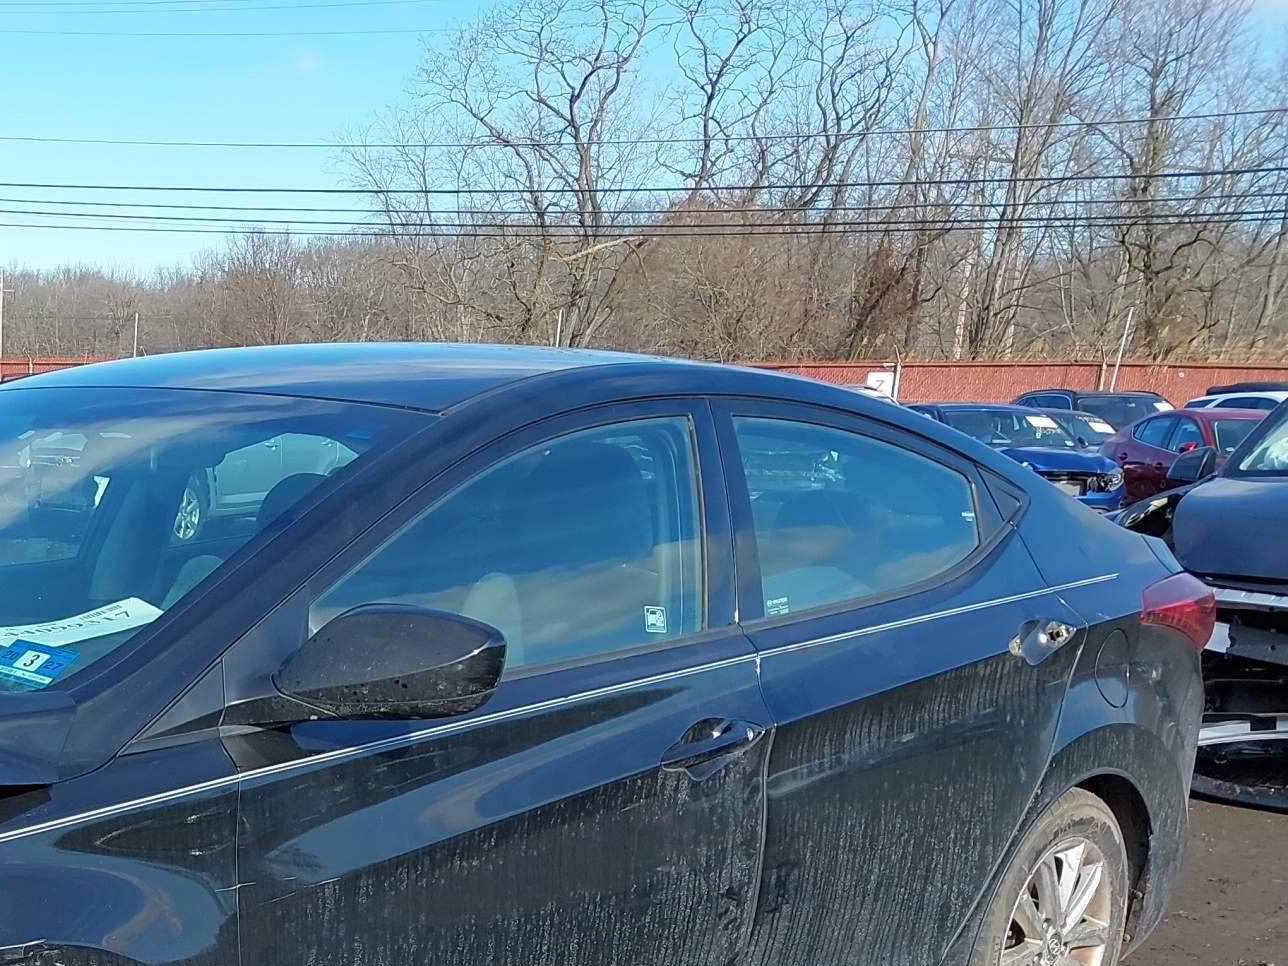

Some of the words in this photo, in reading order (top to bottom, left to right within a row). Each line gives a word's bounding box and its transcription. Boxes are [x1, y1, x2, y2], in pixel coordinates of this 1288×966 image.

[1, 650, 20, 661] 20
[23, 654, 41, 667] 3
[43, 660, 65, 671] 27
